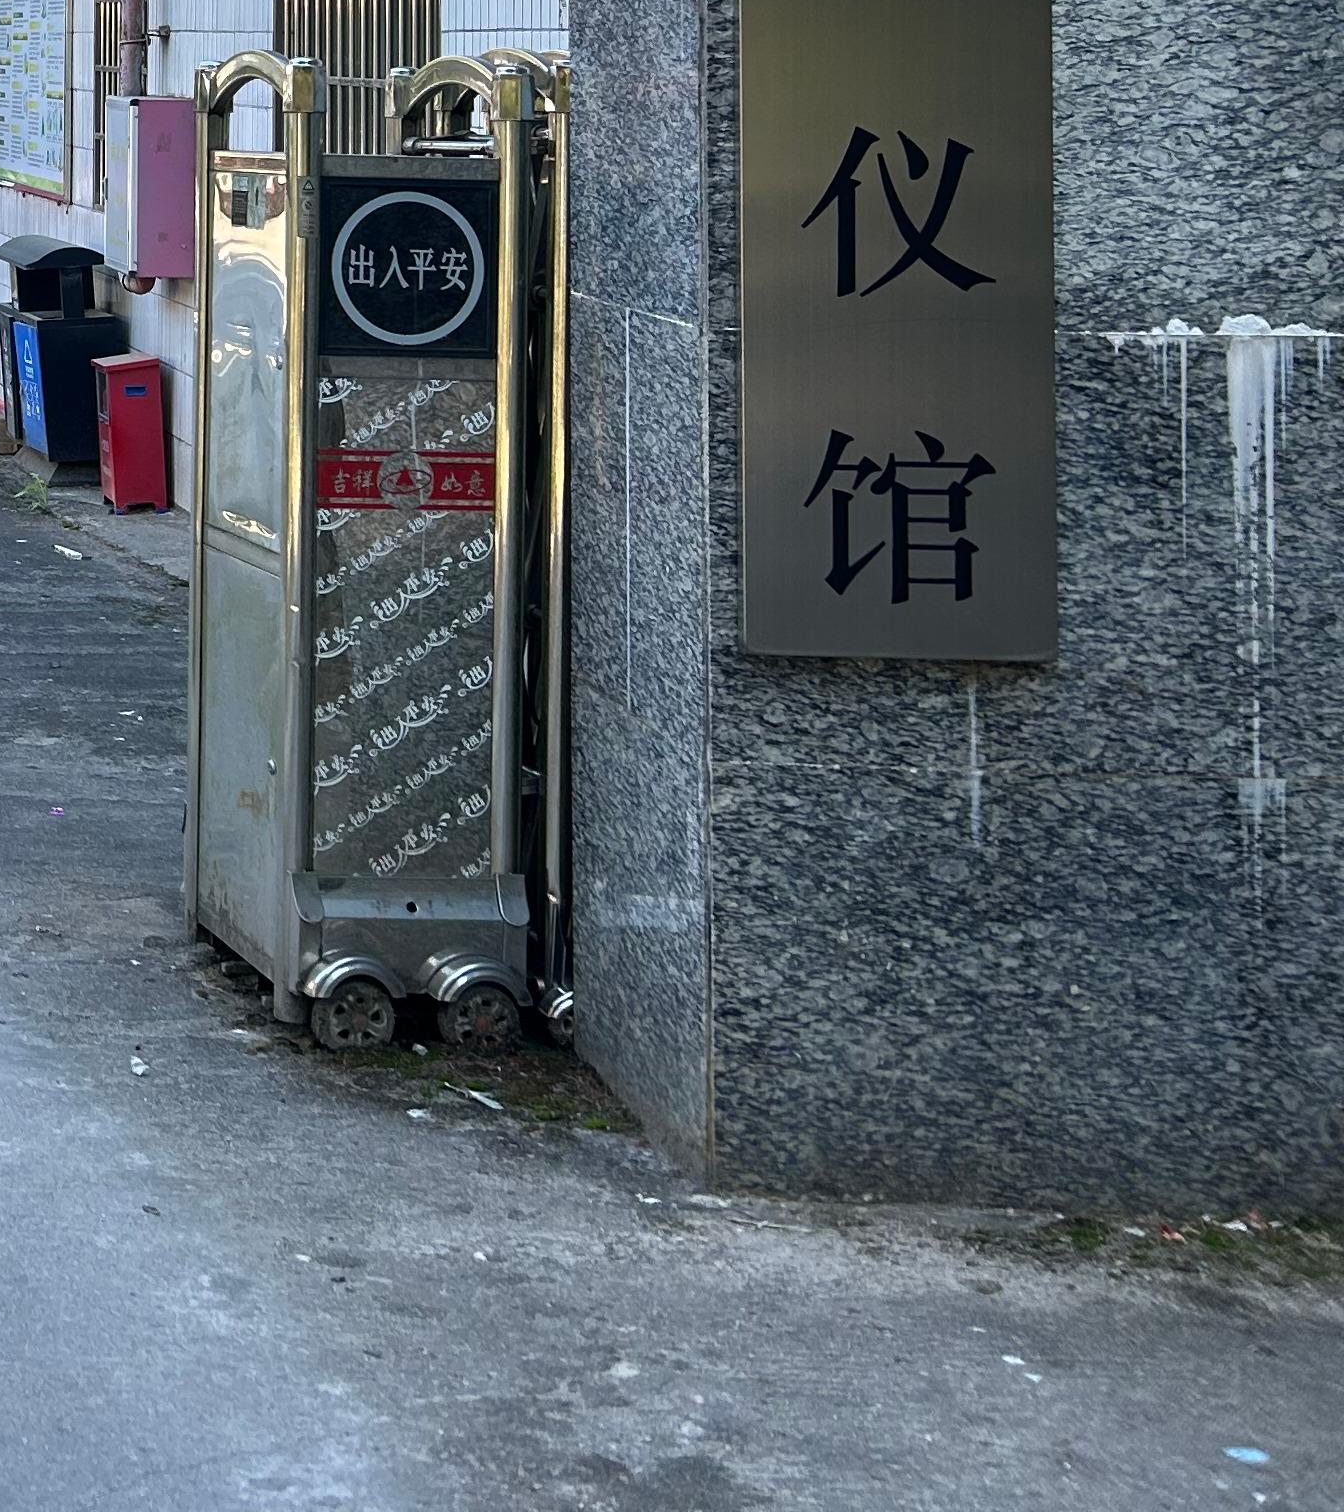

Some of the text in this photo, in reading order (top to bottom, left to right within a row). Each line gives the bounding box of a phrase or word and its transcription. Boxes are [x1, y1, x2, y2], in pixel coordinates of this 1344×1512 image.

[348, 245, 469, 291] 出入平安
[333, 467, 486, 496] 吉祥 如意
